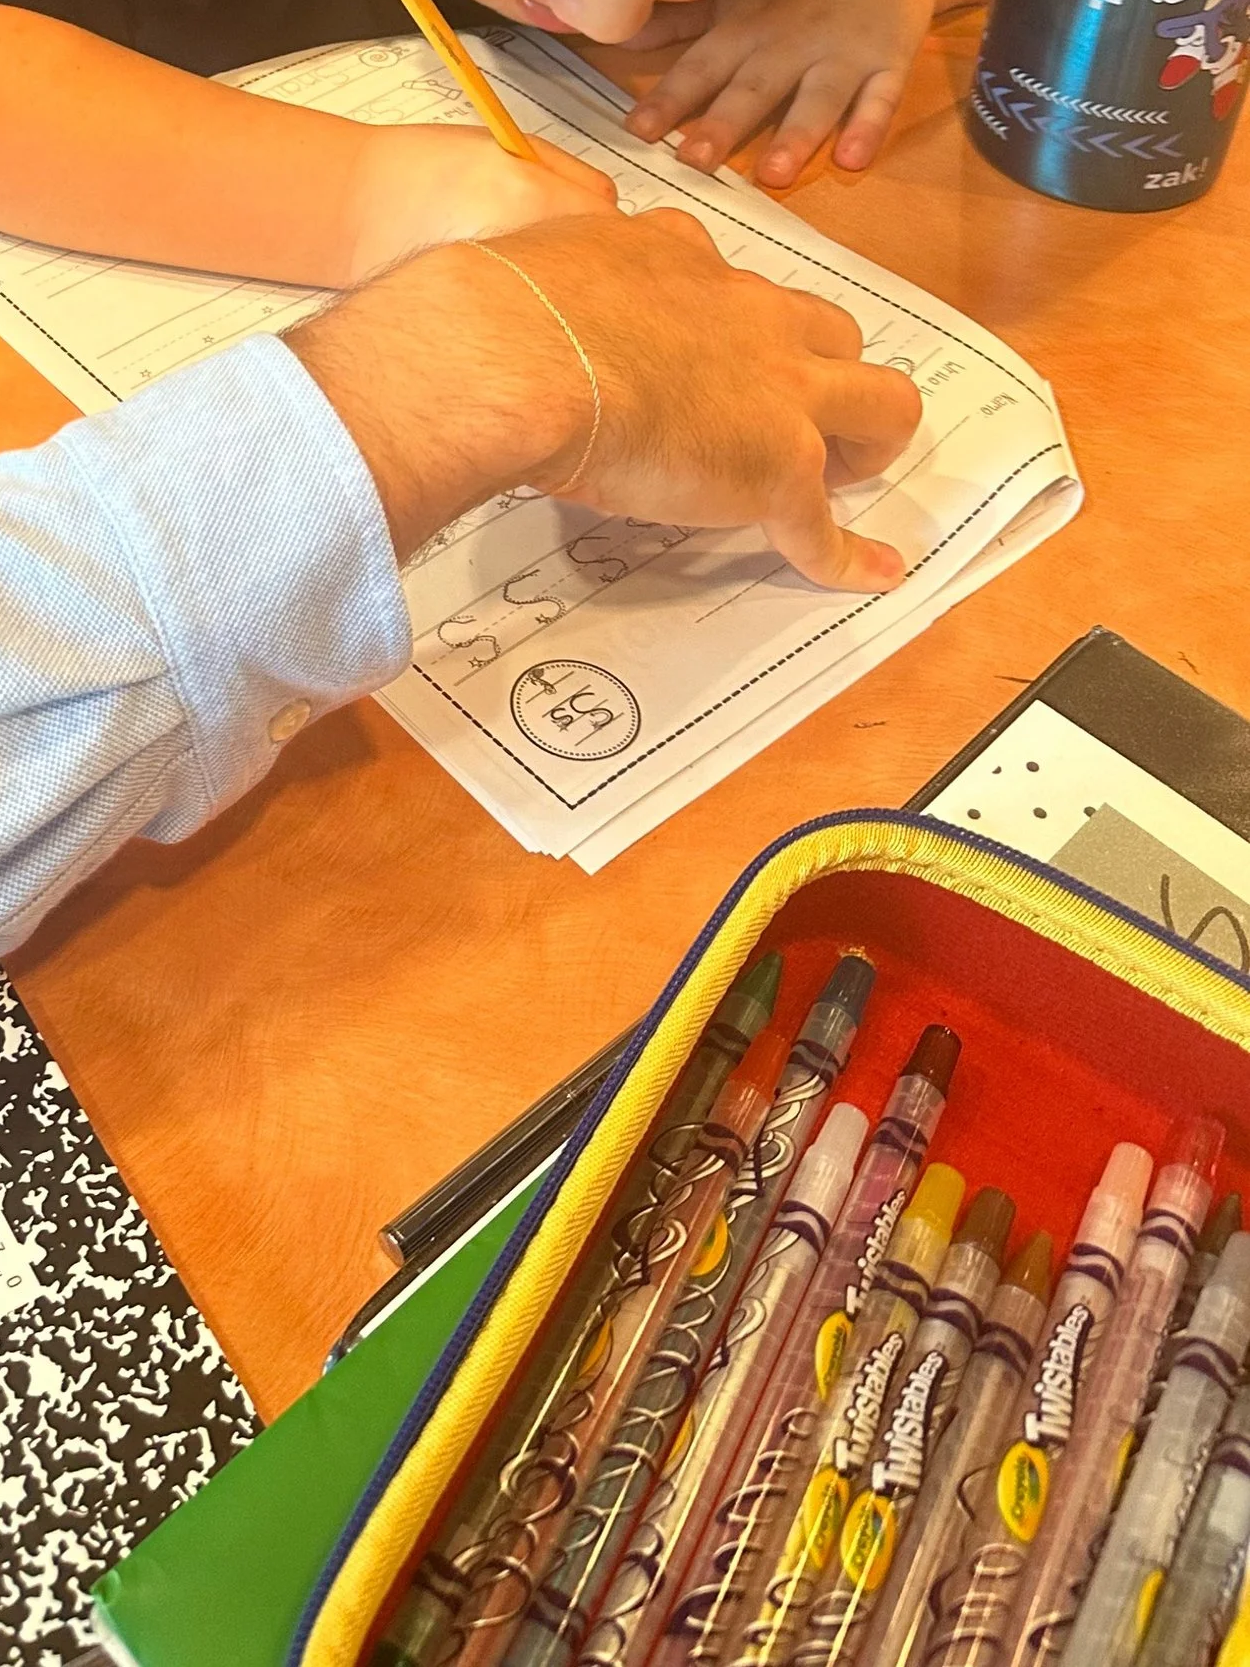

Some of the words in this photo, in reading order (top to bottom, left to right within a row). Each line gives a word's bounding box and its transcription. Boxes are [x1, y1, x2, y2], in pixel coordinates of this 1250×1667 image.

[1143, 156, 1209, 190] zak!
[5, 1273, 23, 1289] 0
[836, 1332, 905, 1466] Twistables
[875, 1350, 944, 1488] Twistables
[1026, 1303, 1088, 1438] Twistables
